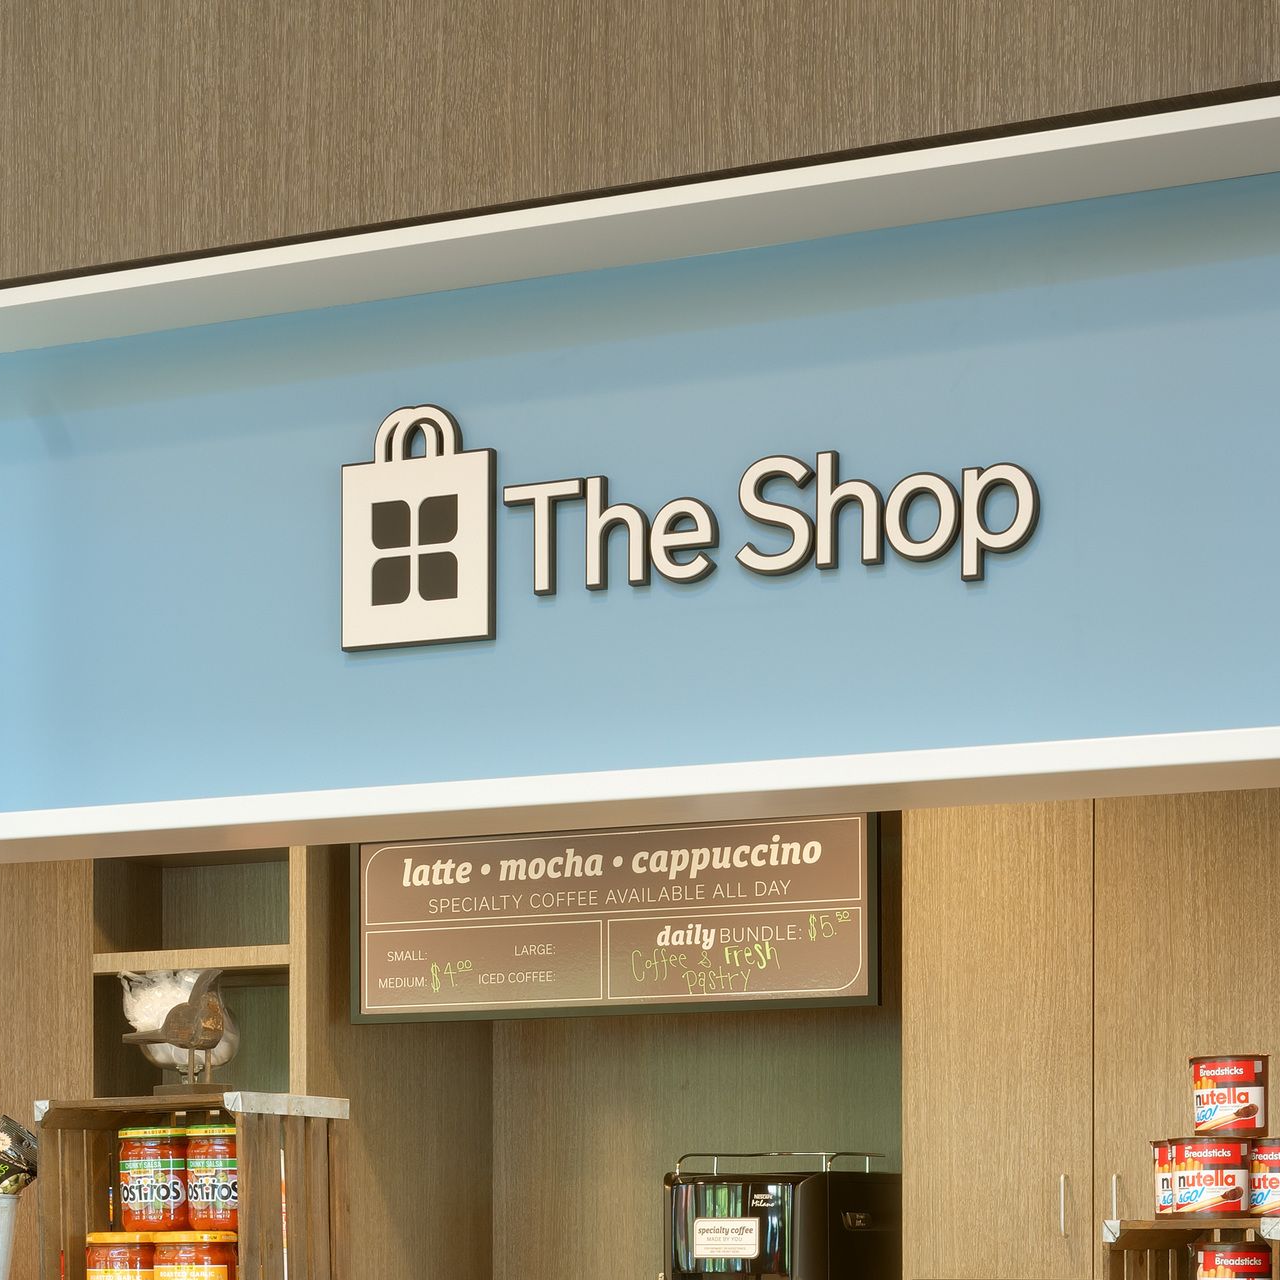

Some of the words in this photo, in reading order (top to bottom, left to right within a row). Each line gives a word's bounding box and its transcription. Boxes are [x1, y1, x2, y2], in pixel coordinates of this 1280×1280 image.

[503, 475, 719, 596] The
[735, 451, 1040, 582] Shop
[402, 856, 471, 888] latte
[499, 847, 604, 882] mocha
[632, 835, 822, 881] cappuccino
[428, 895, 522, 915] SPECIALTY
[529, 889, 598, 909] COFFEE
[605, 885, 705, 905] AVAILABLE
[712, 882, 748, 899] ALL
[755, 879, 792, 898] DAY
[656, 924, 716, 951] daily
[719, 924, 803, 945] BUNDLE:
[386, 948, 428, 963] SMALL:
[514, 943, 556, 957] LARGE:
[631, 947, 687, 984] Coffee
[724, 940, 779, 970] Fresh
[378, 975, 428, 989] MEDIUM:
[478, 972, 505, 986] ICED
[507, 969, 556, 984] COFFEE:
[1200, 1066, 1244, 1077] Breadsticks
[1195, 1087, 1250, 1106] nutella
[1184, 1148, 1231, 1158] Breadsticks
[1178, 1170, 1236, 1187] nutella
[1178, 1187, 1205, 1203] &GO!
[751, 1200, 776, 1208] Milano
[698, 1226, 730, 1236] specialty
[731, 1226, 754, 1235] coffee
[1215, 1257, 1262, 1266] Breadsticks
